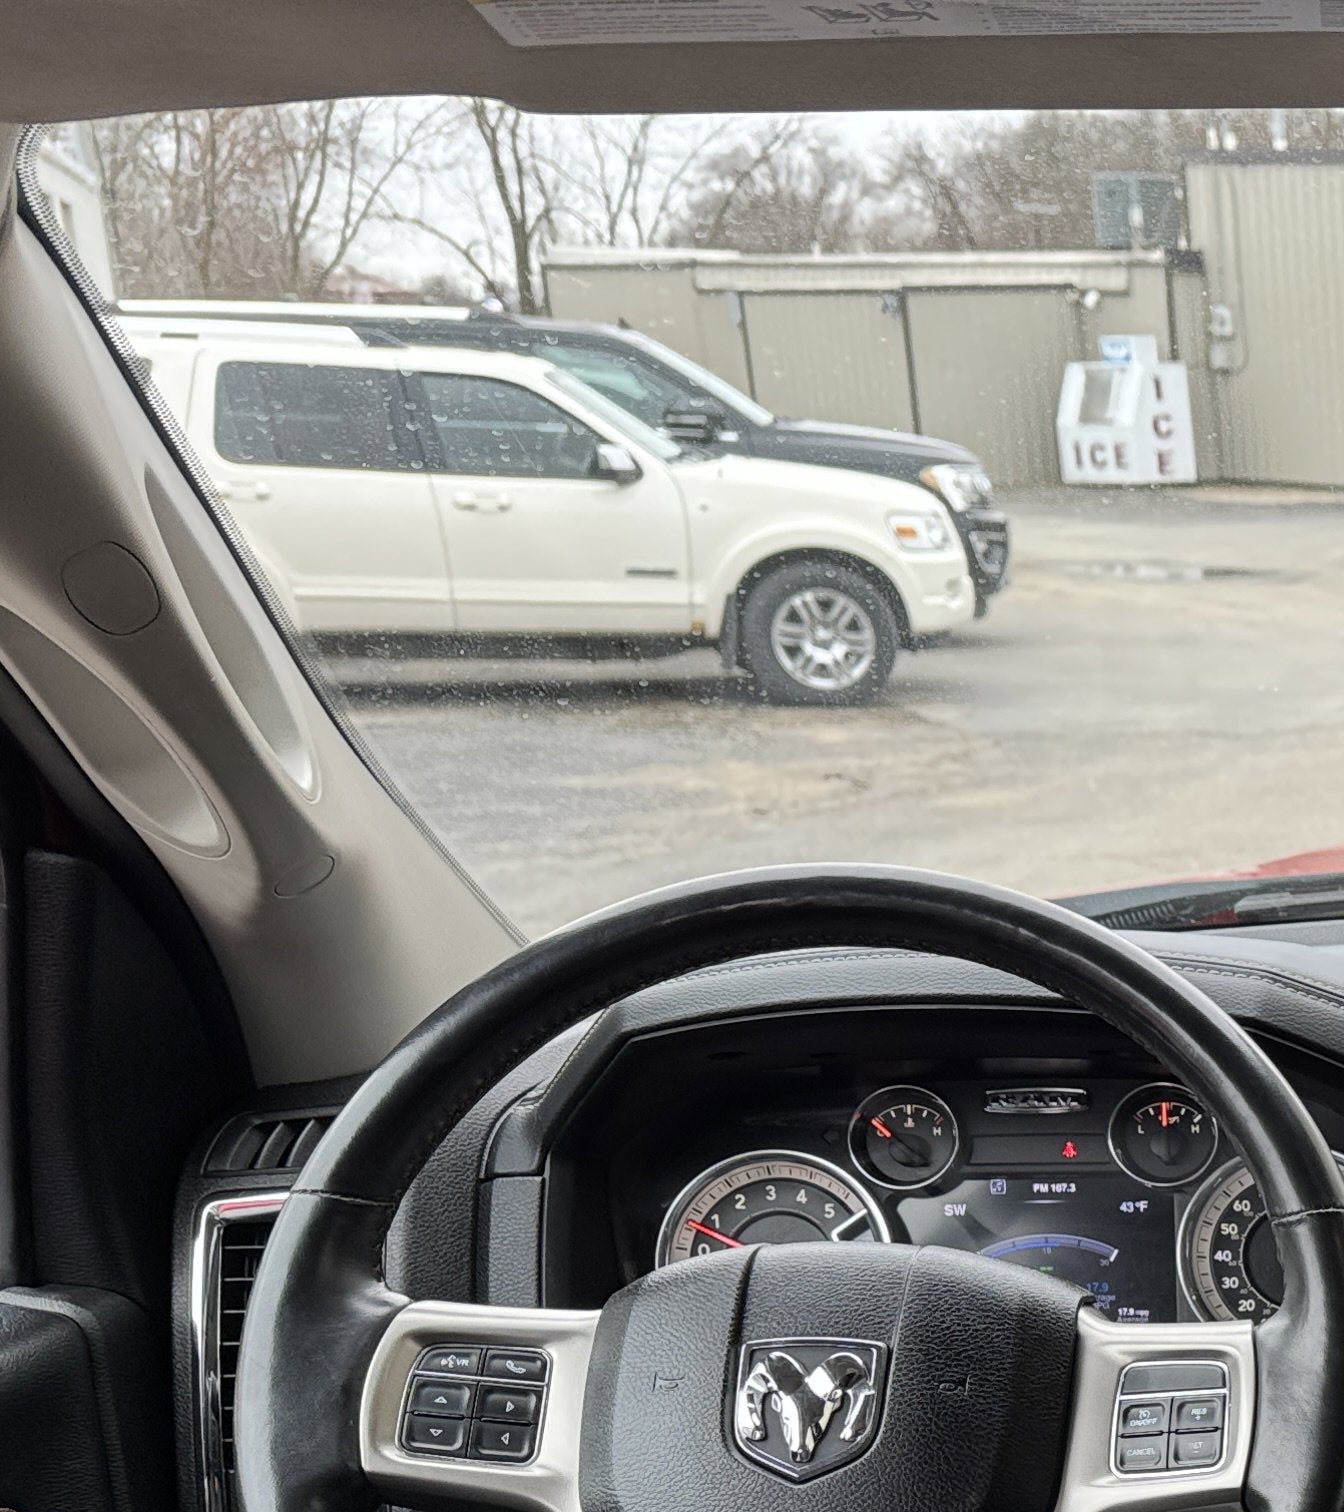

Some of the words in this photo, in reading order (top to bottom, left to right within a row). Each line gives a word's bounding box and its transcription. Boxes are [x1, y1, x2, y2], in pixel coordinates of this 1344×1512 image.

[1073, 440, 1129, 471] ICE
[933, 1128, 942, 1136] H
[1138, 1126, 1144, 1134] L
[1192, 1125, 1200, 1133] H
[766, 1185, 776, 1200] 3
[1032, 1182, 1049, 1193] FM
[1050, 1182, 1076, 1193] 107.3
[734, 1194, 746, 1209] 2
[796, 1189, 807, 1204] 4
[824, 1204, 835, 1218] 5
[944, 1204, 966, 1216] SW
[1233, 1200, 1250, 1212] 60
[711, 1214, 720, 1228] 1
[1220, 1223, 1238, 1235] 50
[1214, 1250, 1232, 1262] 40
[1087, 1282, 1108, 1293] 17.9
[1221, 1277, 1239, 1289] 30
[1238, 1300, 1255, 1312] 20
[1126, 1447, 1155, 1456] CANCEL
